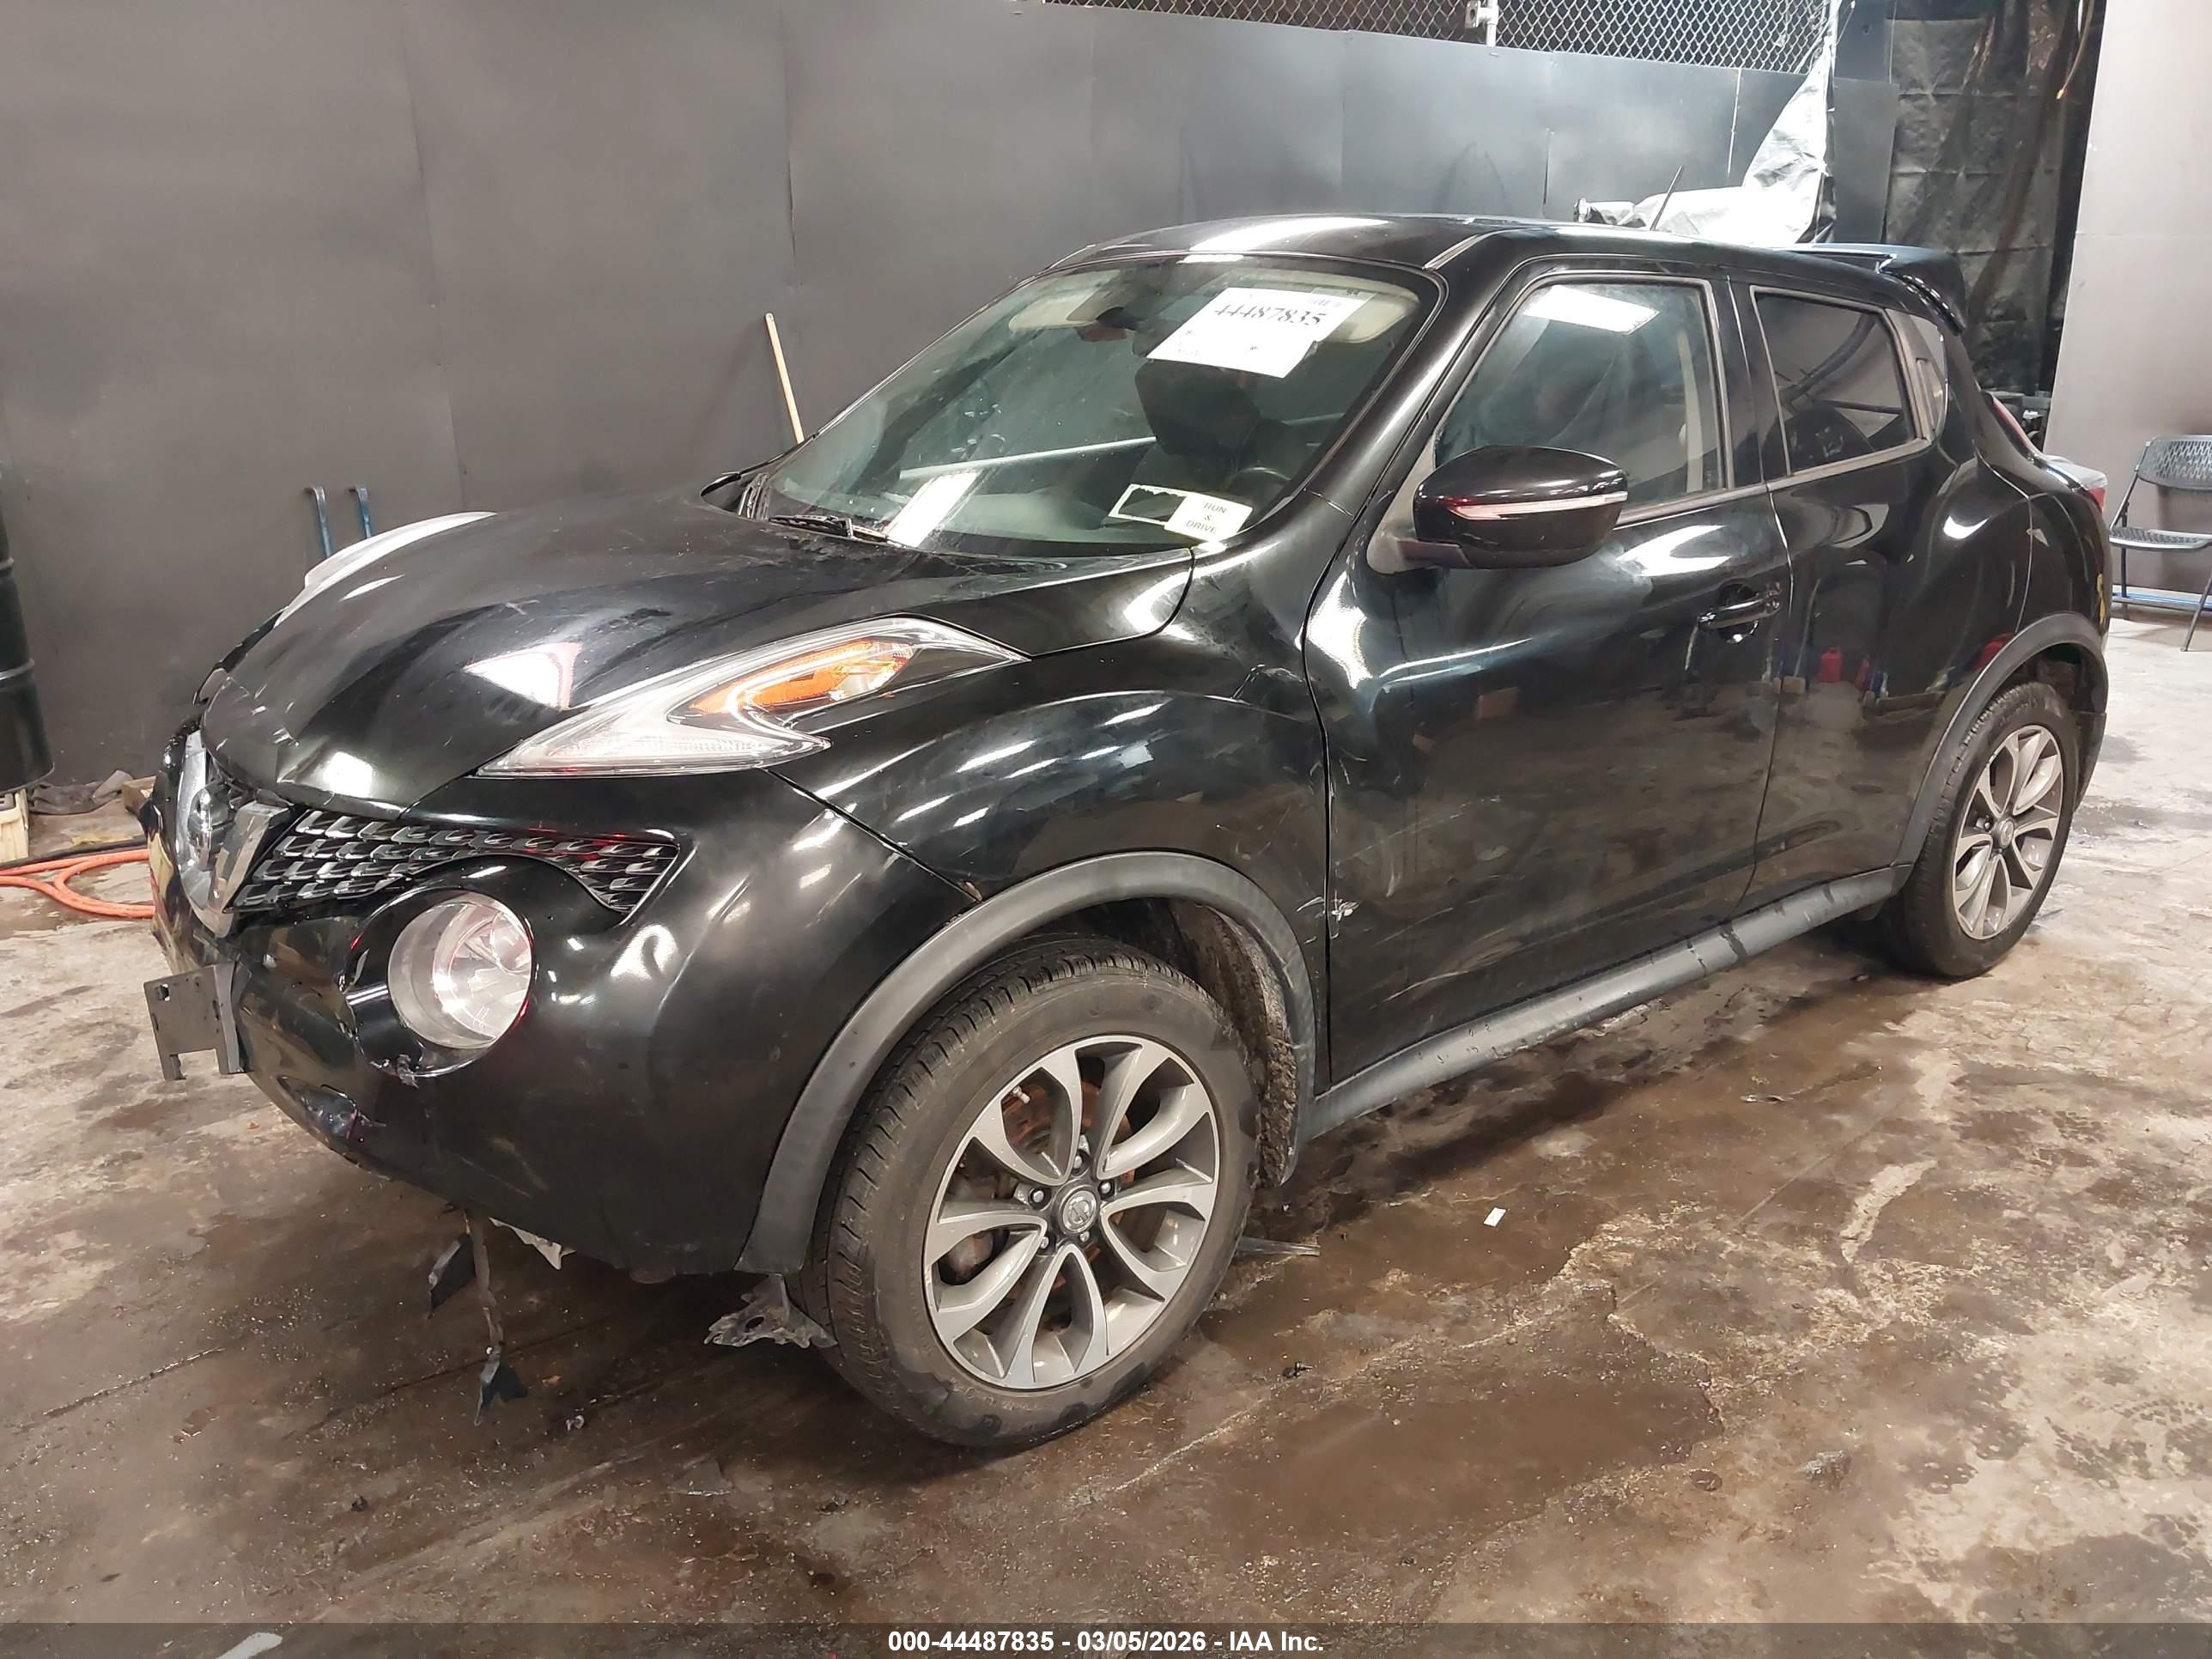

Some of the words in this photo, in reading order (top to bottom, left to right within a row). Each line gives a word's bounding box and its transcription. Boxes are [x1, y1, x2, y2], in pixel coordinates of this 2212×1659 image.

[1213, 303, 1328, 326] 44487835
[1203, 502, 1227, 514] RUN
[1185, 520, 1217, 534] DRIVE
